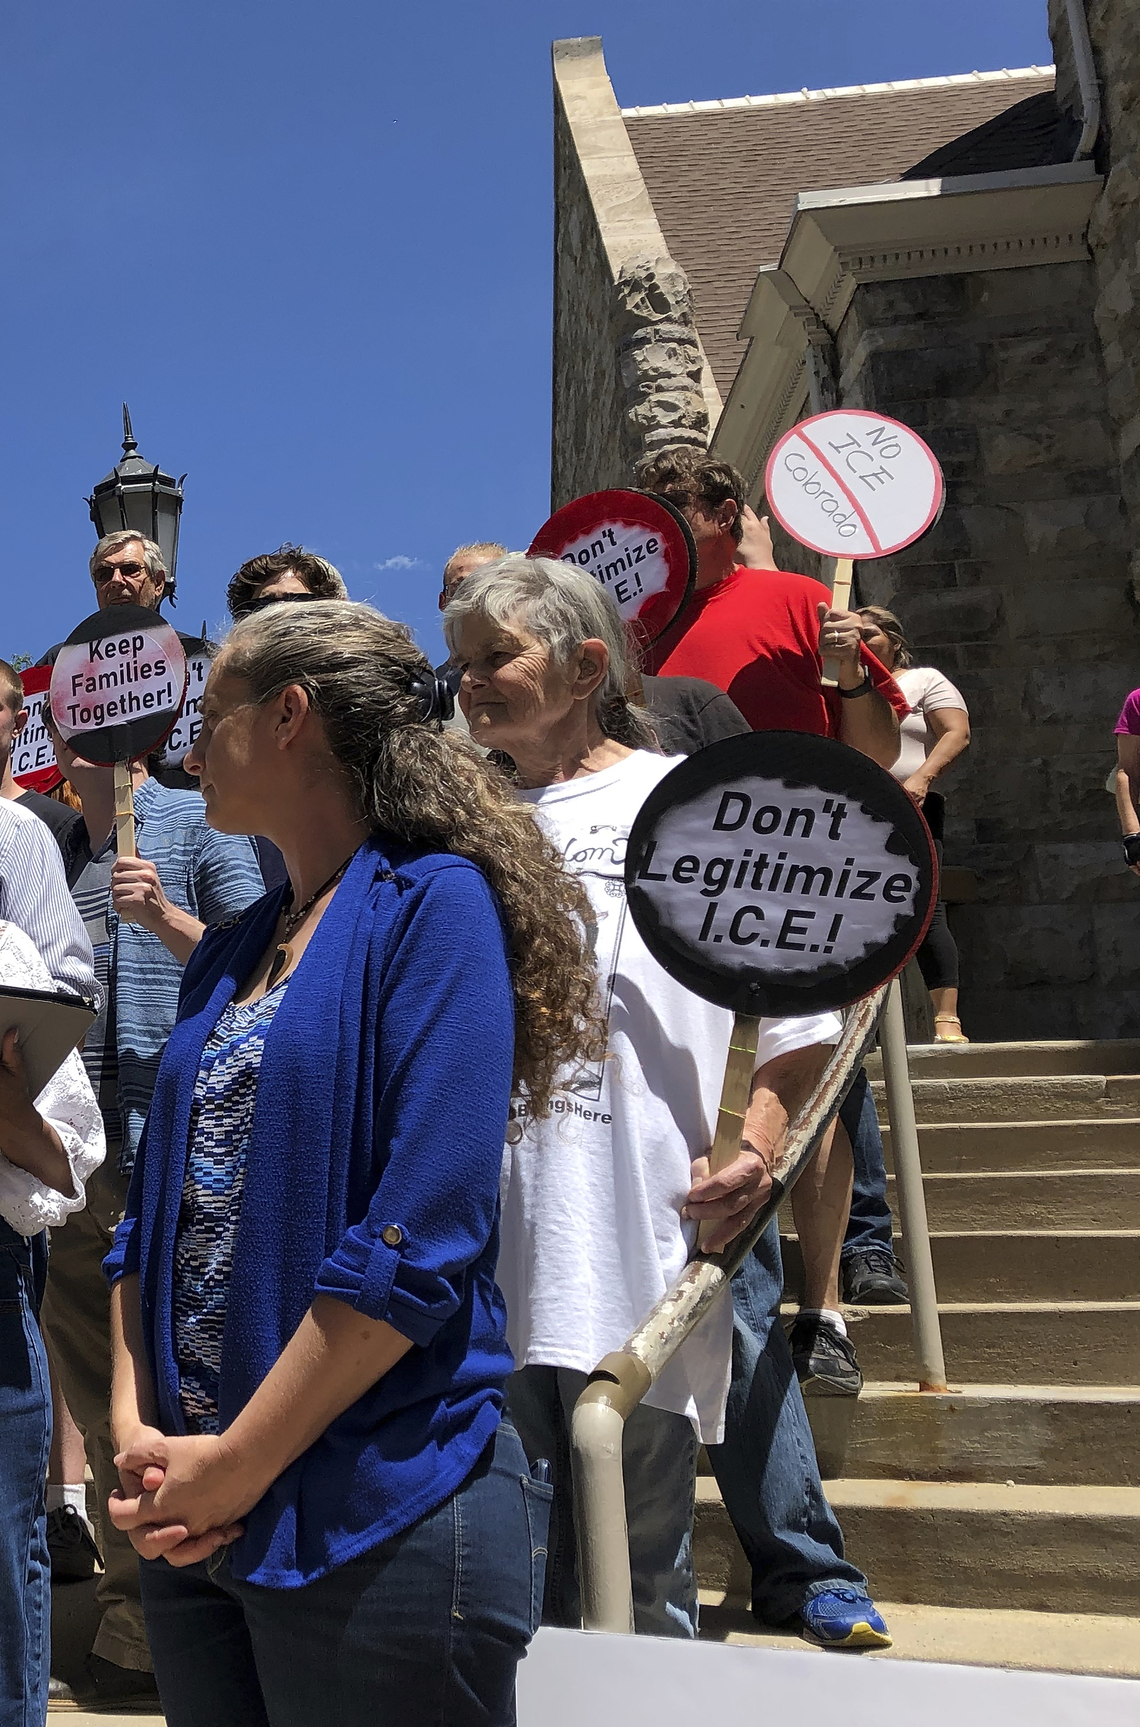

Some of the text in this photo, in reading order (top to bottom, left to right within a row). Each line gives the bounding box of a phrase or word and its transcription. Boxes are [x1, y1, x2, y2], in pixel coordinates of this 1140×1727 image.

[827, 432, 895, 492] ICE
[865, 426, 902, 460] NO
[89, 634, 144, 663] Keep
[71, 659, 166, 696] Families
[67, 682, 173, 726] Together!
[712, 790, 848, 841] Don't
[637, 841, 913, 903] Legitimize
[698, 901, 844, 955] I.C.E.!
